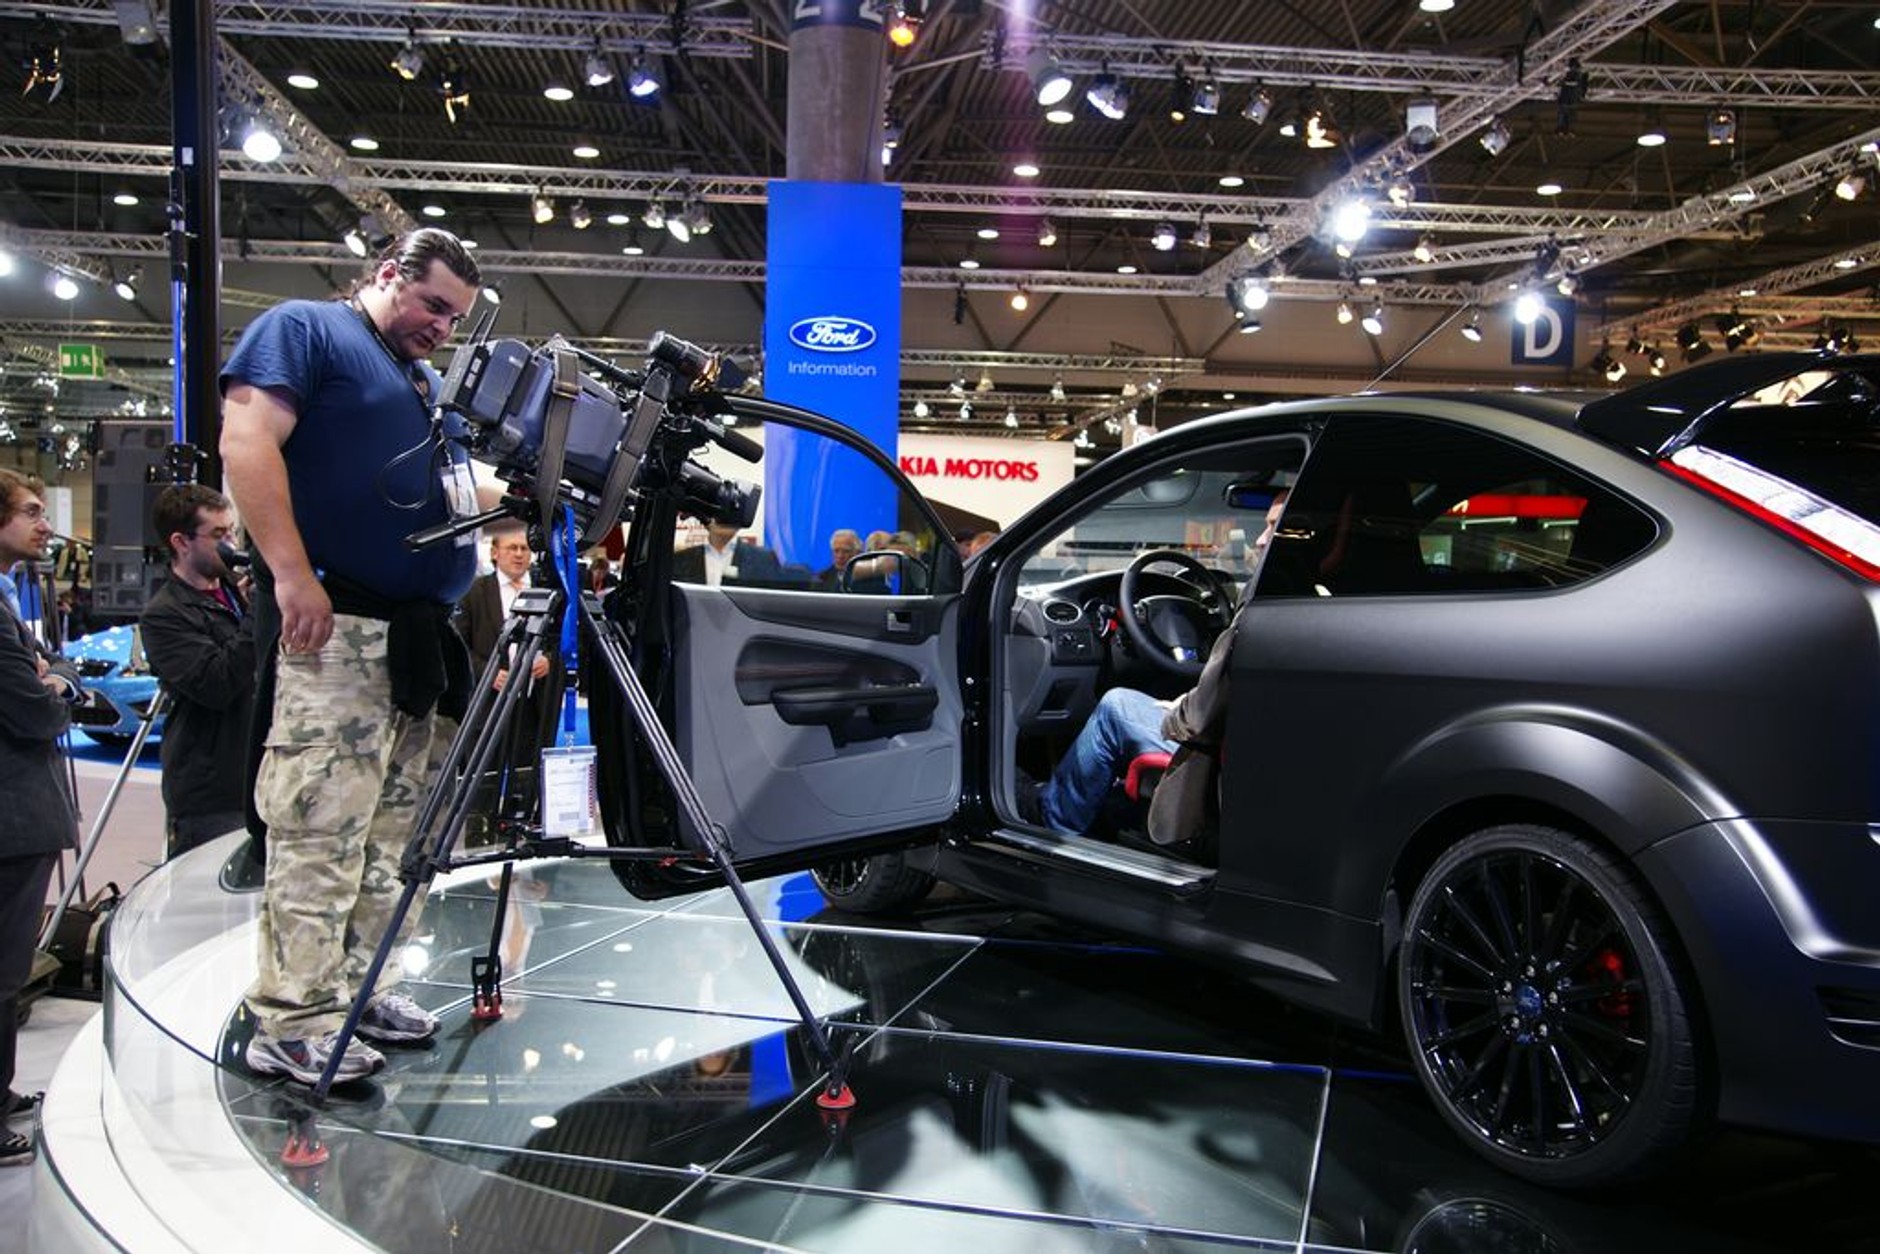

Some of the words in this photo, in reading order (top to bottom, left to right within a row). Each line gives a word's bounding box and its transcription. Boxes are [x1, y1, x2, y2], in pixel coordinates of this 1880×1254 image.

[806, 322, 861, 345] Ford
[1525, 306, 1562, 357] D
[788, 361, 877, 376] Information
[900, 456, 939, 476] KIA
[944, 458, 1039, 482] MOTORS
